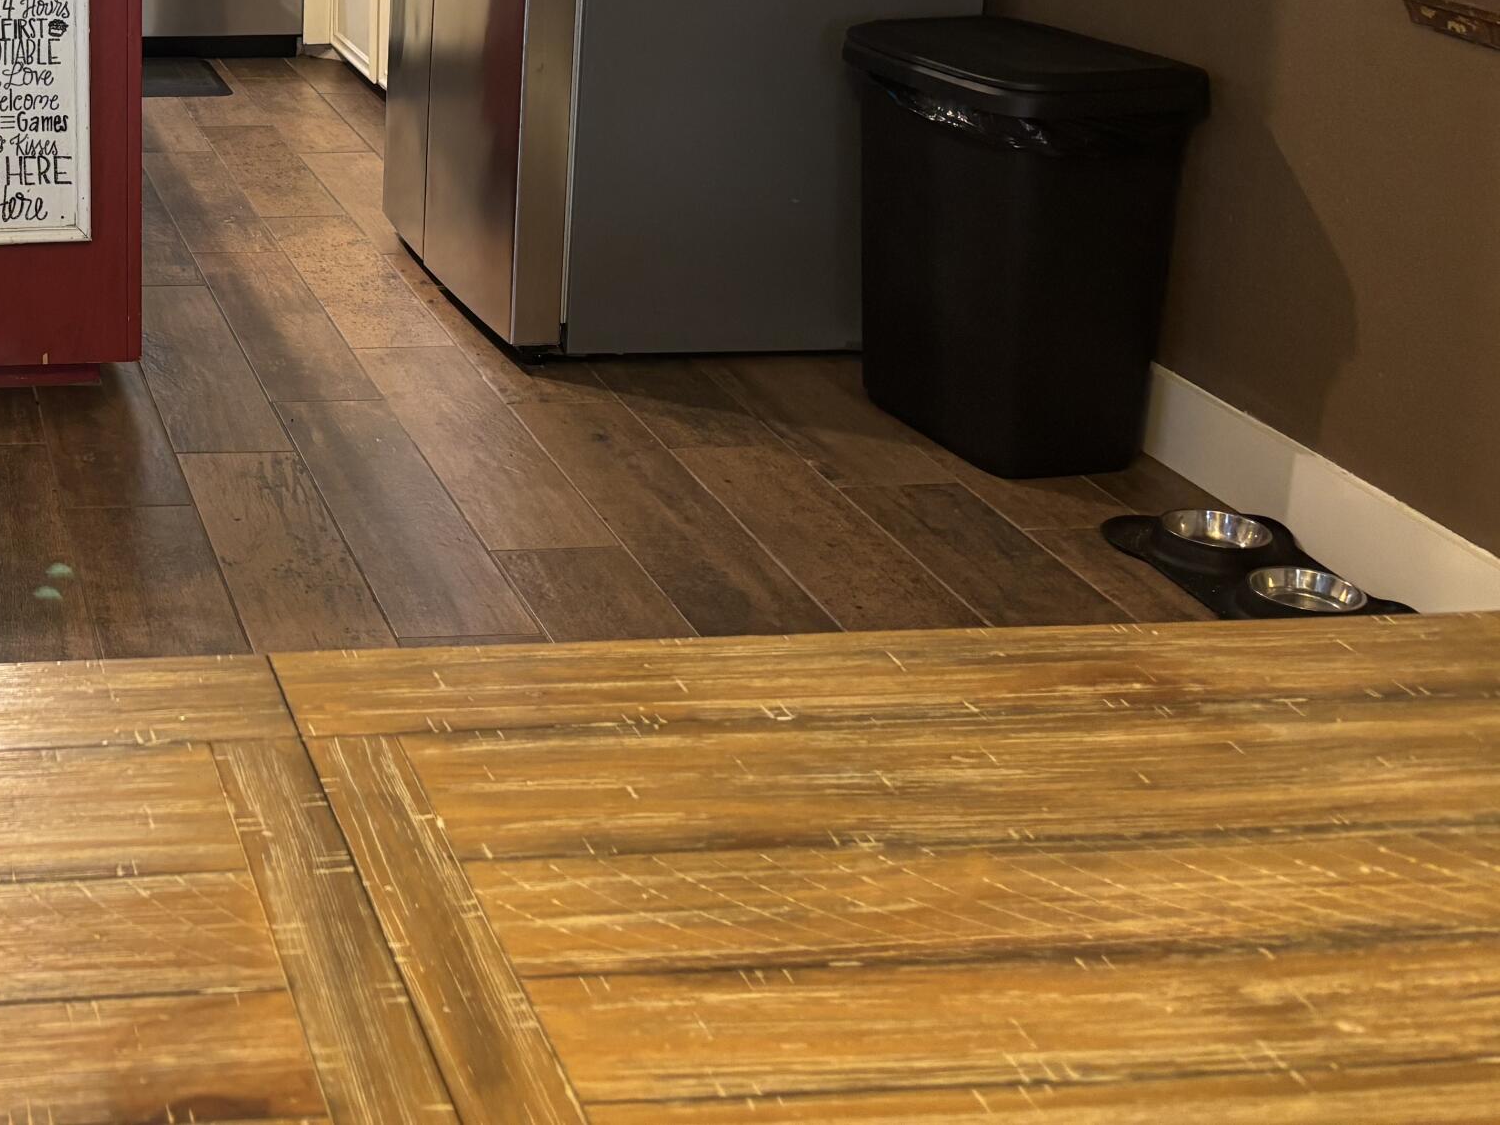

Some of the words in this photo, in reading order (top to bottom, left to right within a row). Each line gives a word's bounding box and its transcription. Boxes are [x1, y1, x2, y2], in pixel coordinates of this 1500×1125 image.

[1, 18, 48, 40] FIRST
[2, 62, 54, 89] Love
[17, 111, 69, 132] Games
[10, 133, 58, 157] Kisses
[5, 156, 73, 186] HERE
